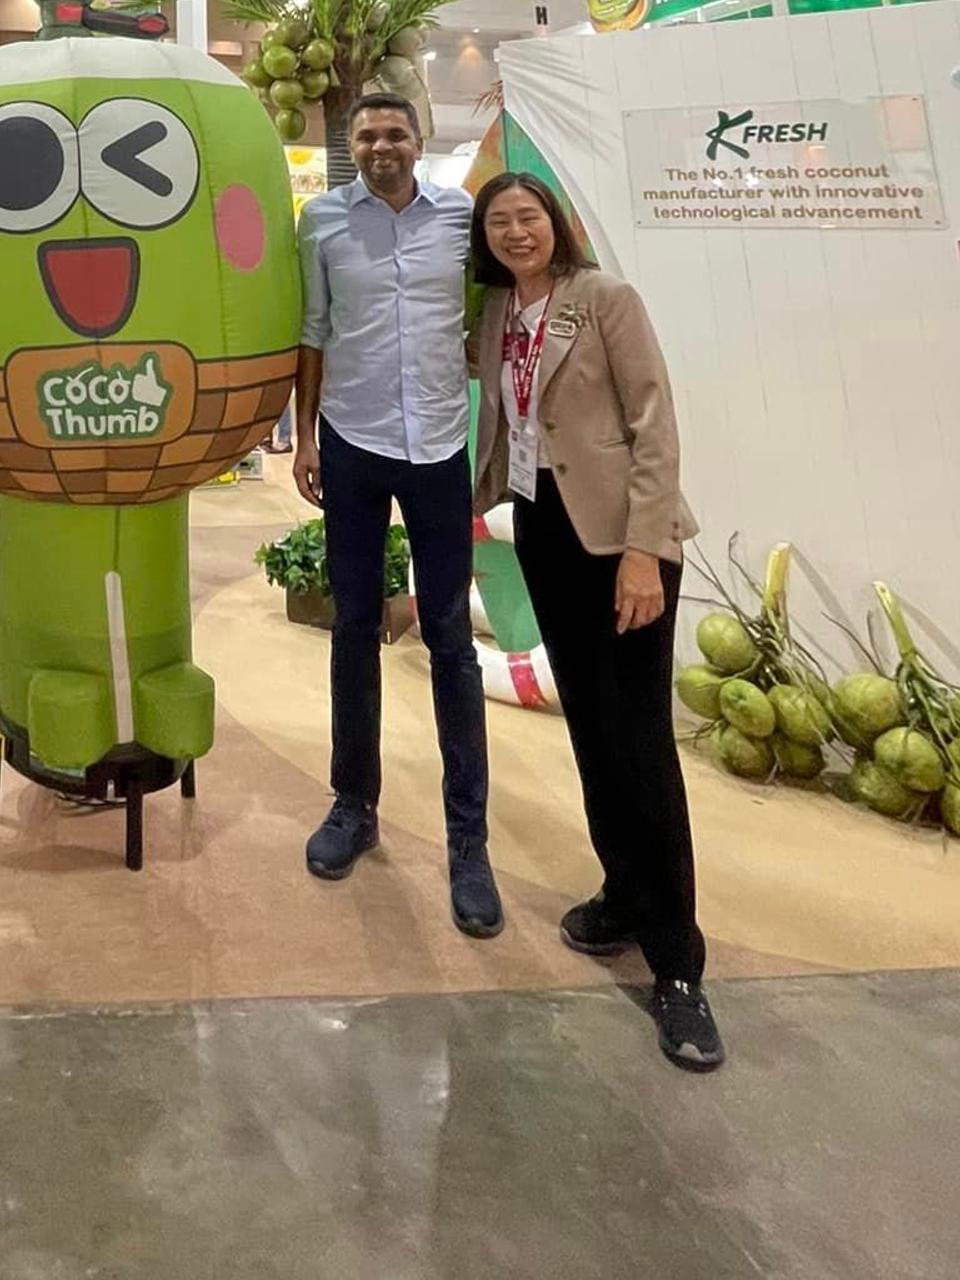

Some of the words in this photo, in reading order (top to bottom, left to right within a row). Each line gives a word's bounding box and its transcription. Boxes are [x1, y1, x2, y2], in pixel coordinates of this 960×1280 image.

[742, 122, 828, 144] FRESH
[665, 168, 698, 181] The
[703, 167, 743, 180] No.1
[750, 166, 799, 180] fresh
[804, 165, 890, 178] coconut
[643, 186, 763, 200] manufacturer
[769, 184, 810, 199] with
[815, 183, 924, 199] innovative
[654, 205, 775, 220] technological
[781, 204, 923, 219] advancement
[46, 406, 159, 436] Thumb
